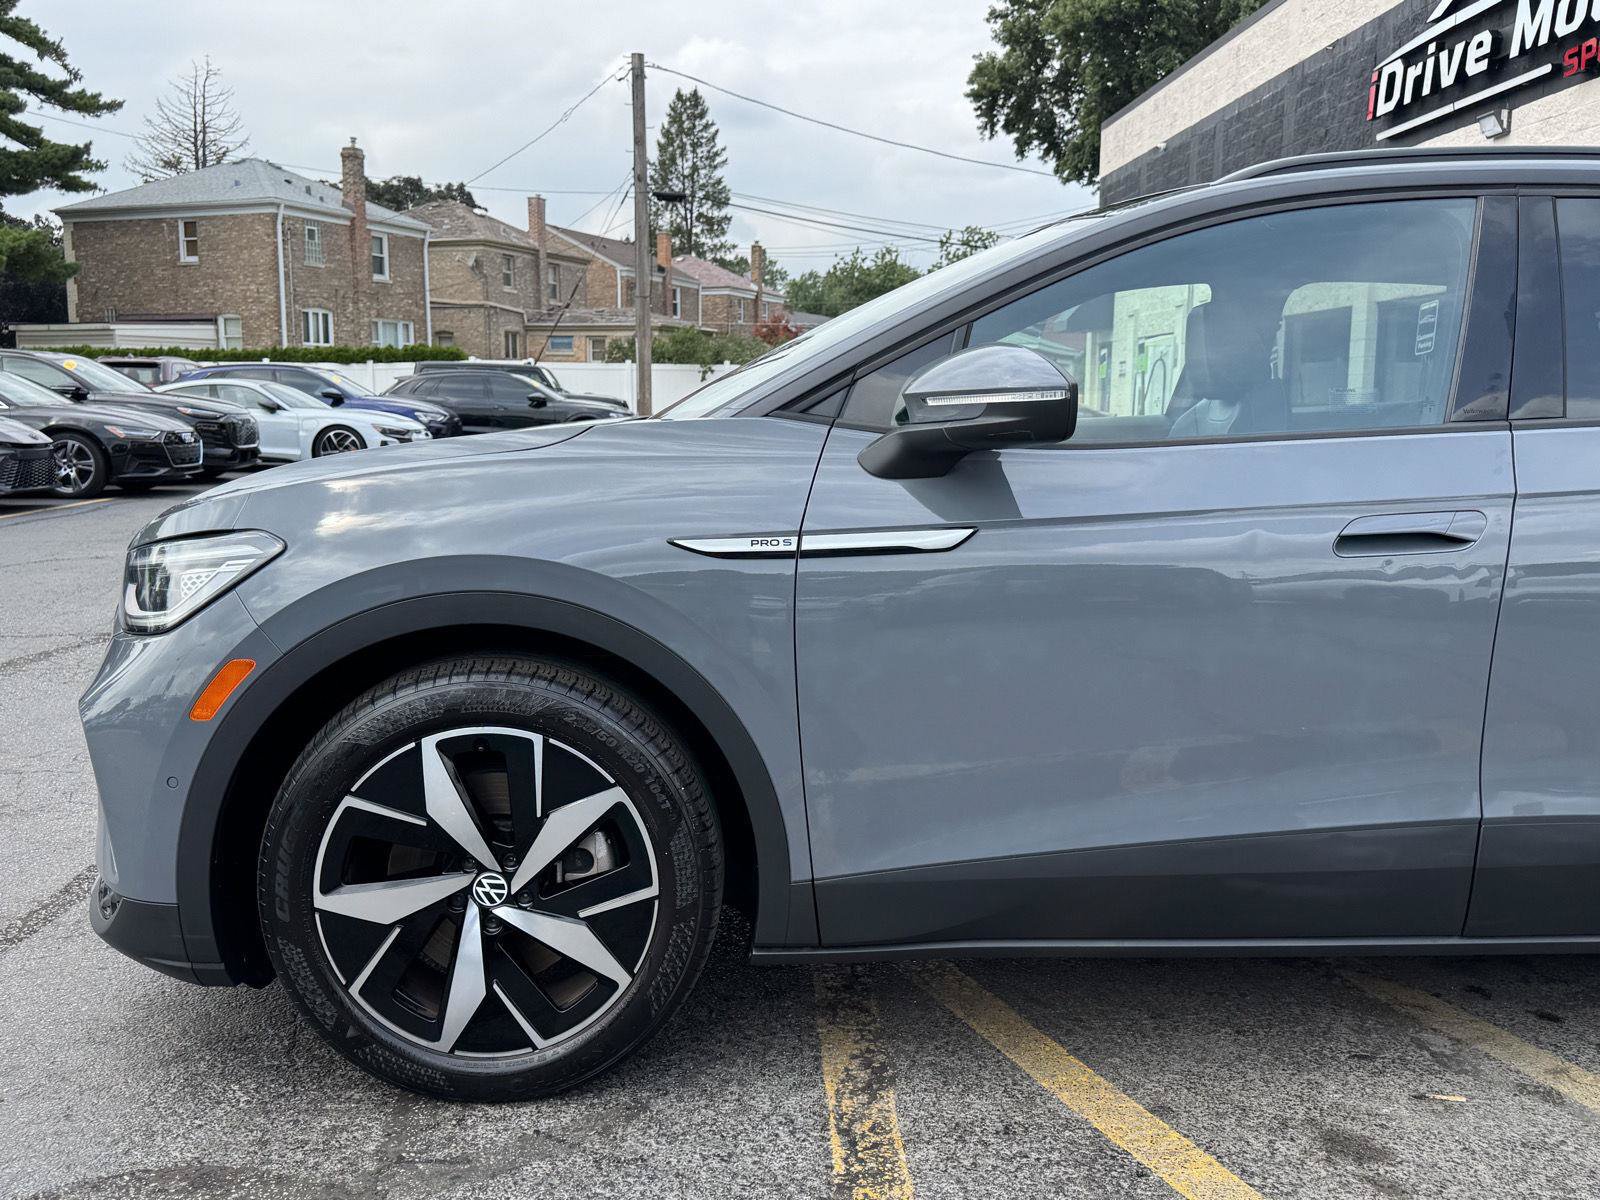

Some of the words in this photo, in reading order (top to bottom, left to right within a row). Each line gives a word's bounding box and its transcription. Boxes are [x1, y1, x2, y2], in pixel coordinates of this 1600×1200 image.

[1367, 29, 1493, 121] iDrive
[1509, 0, 1600, 59] Mo
[1563, 36, 1600, 78] SP
[751, 538, 780, 547] PRO
[782, 538, 793, 547] S
